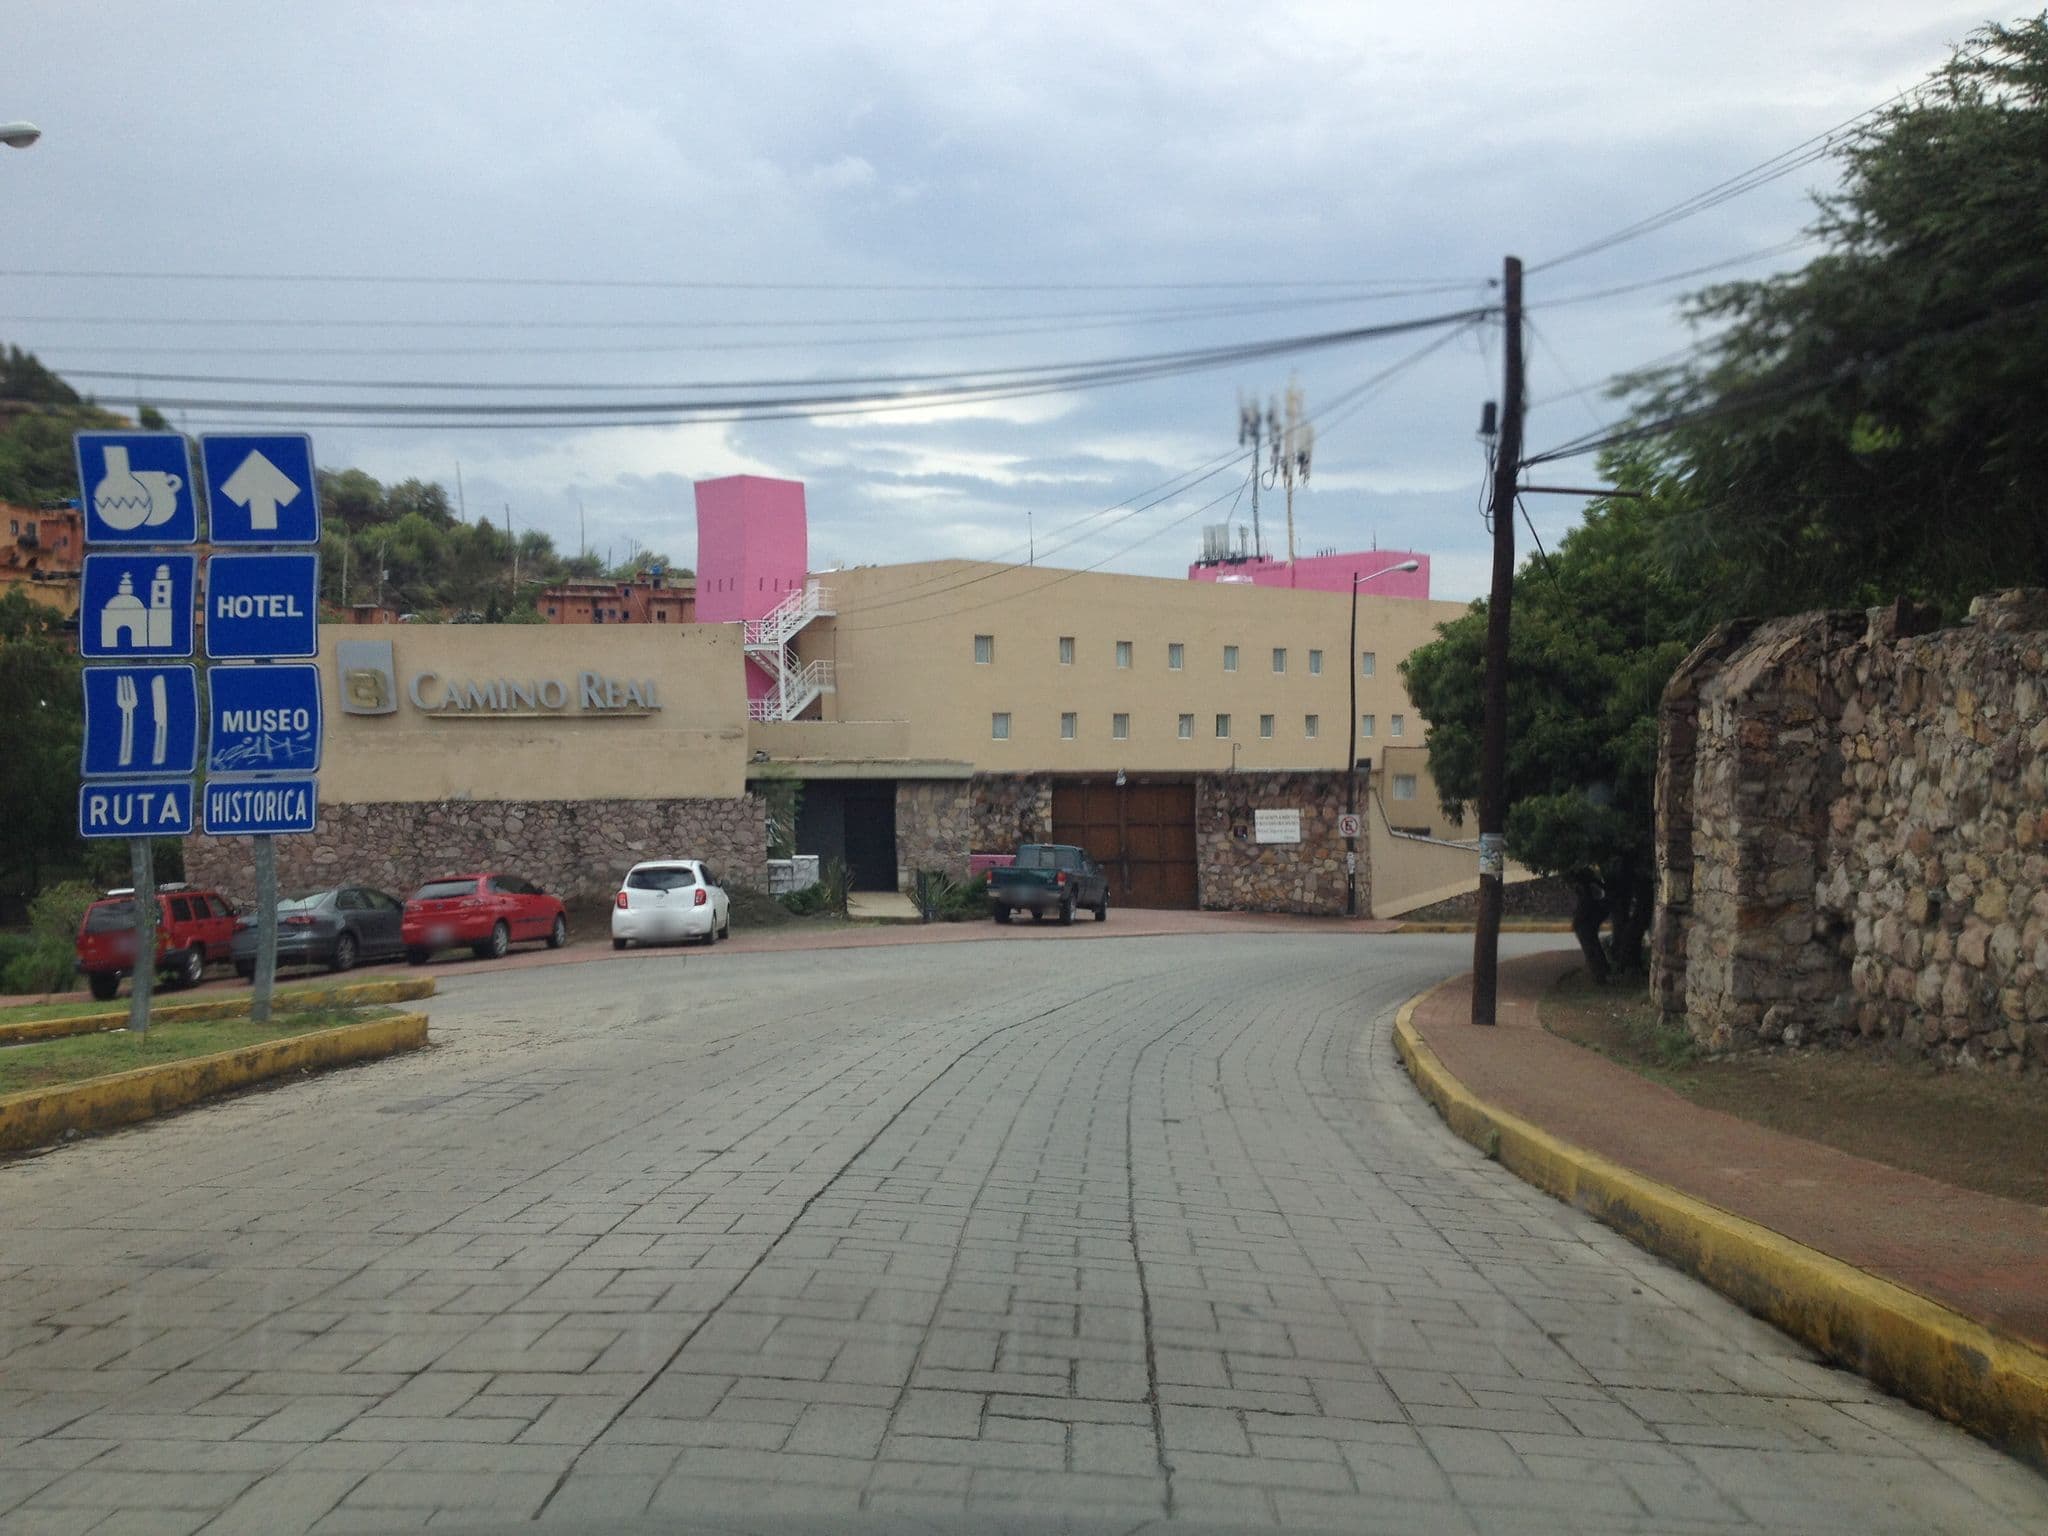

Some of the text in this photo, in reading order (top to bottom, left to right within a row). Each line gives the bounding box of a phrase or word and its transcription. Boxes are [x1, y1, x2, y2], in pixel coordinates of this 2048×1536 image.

[217, 595, 304, 618] HOTEL
[408, 671, 663, 711] CAMINO REAL
[222, 708, 309, 733] MUSEO
[90, 793, 181, 826] RUTA
[212, 789, 307, 823] HISTORICA
